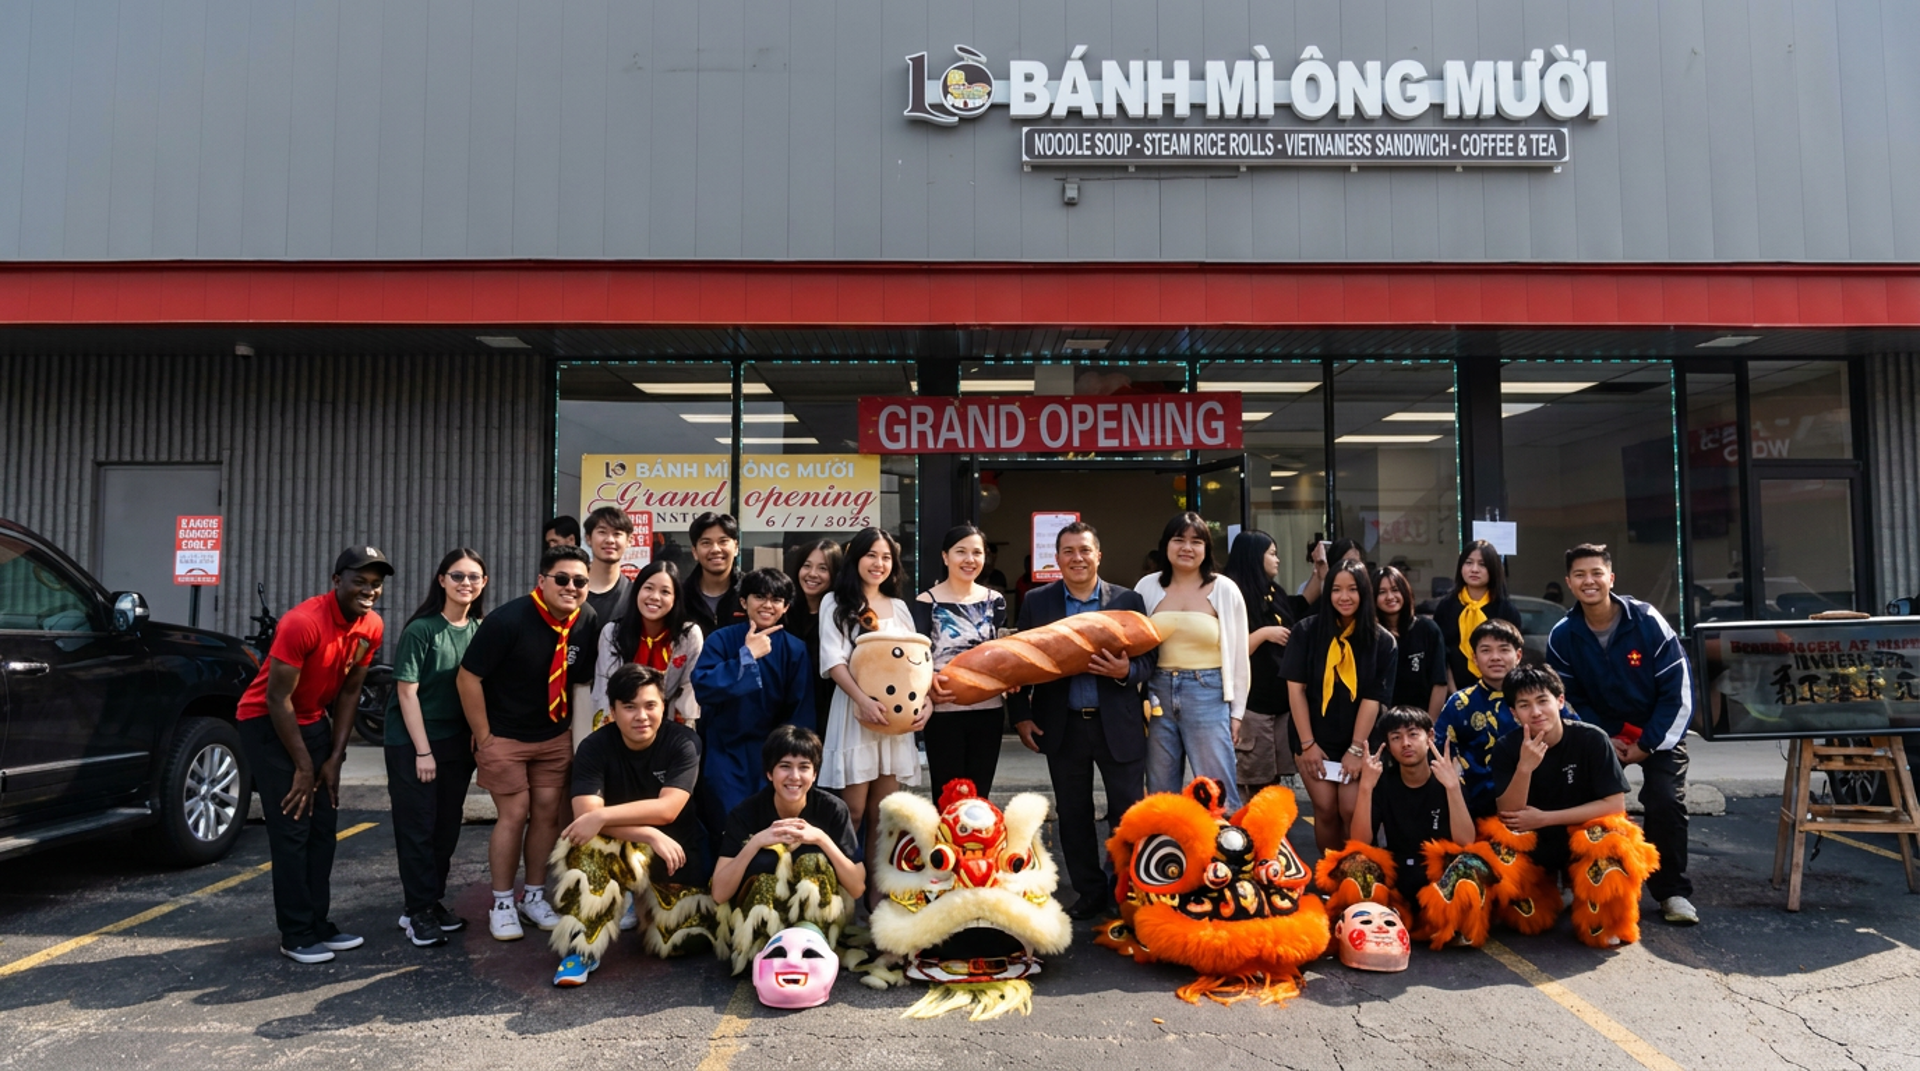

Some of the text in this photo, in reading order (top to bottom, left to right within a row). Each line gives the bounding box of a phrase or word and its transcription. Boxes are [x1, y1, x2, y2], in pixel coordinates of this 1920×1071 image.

[1009, 45, 1190, 119] BÁNH
[1205, 45, 1275, 119] MÌ
[1290, 45, 1430, 120] ÔNG
[1443, 44, 1608, 120] MƯỜI
[1095, 132, 1133, 156] SOUP
[1143, 132, 1190, 156] STEAM
[1193, 132, 1226, 156] RICE
[1229, 132, 1275, 156] ROLLS
[1375, 133, 1450, 156] SANDWICH
[1460, 133, 1515, 157] COFFEE
[1518, 133, 1527, 156] &
[1530, 133, 1558, 156] TEA
[877, 400, 1225, 451] GRAND OPENING
[590, 480, 878, 519] Grand opening
